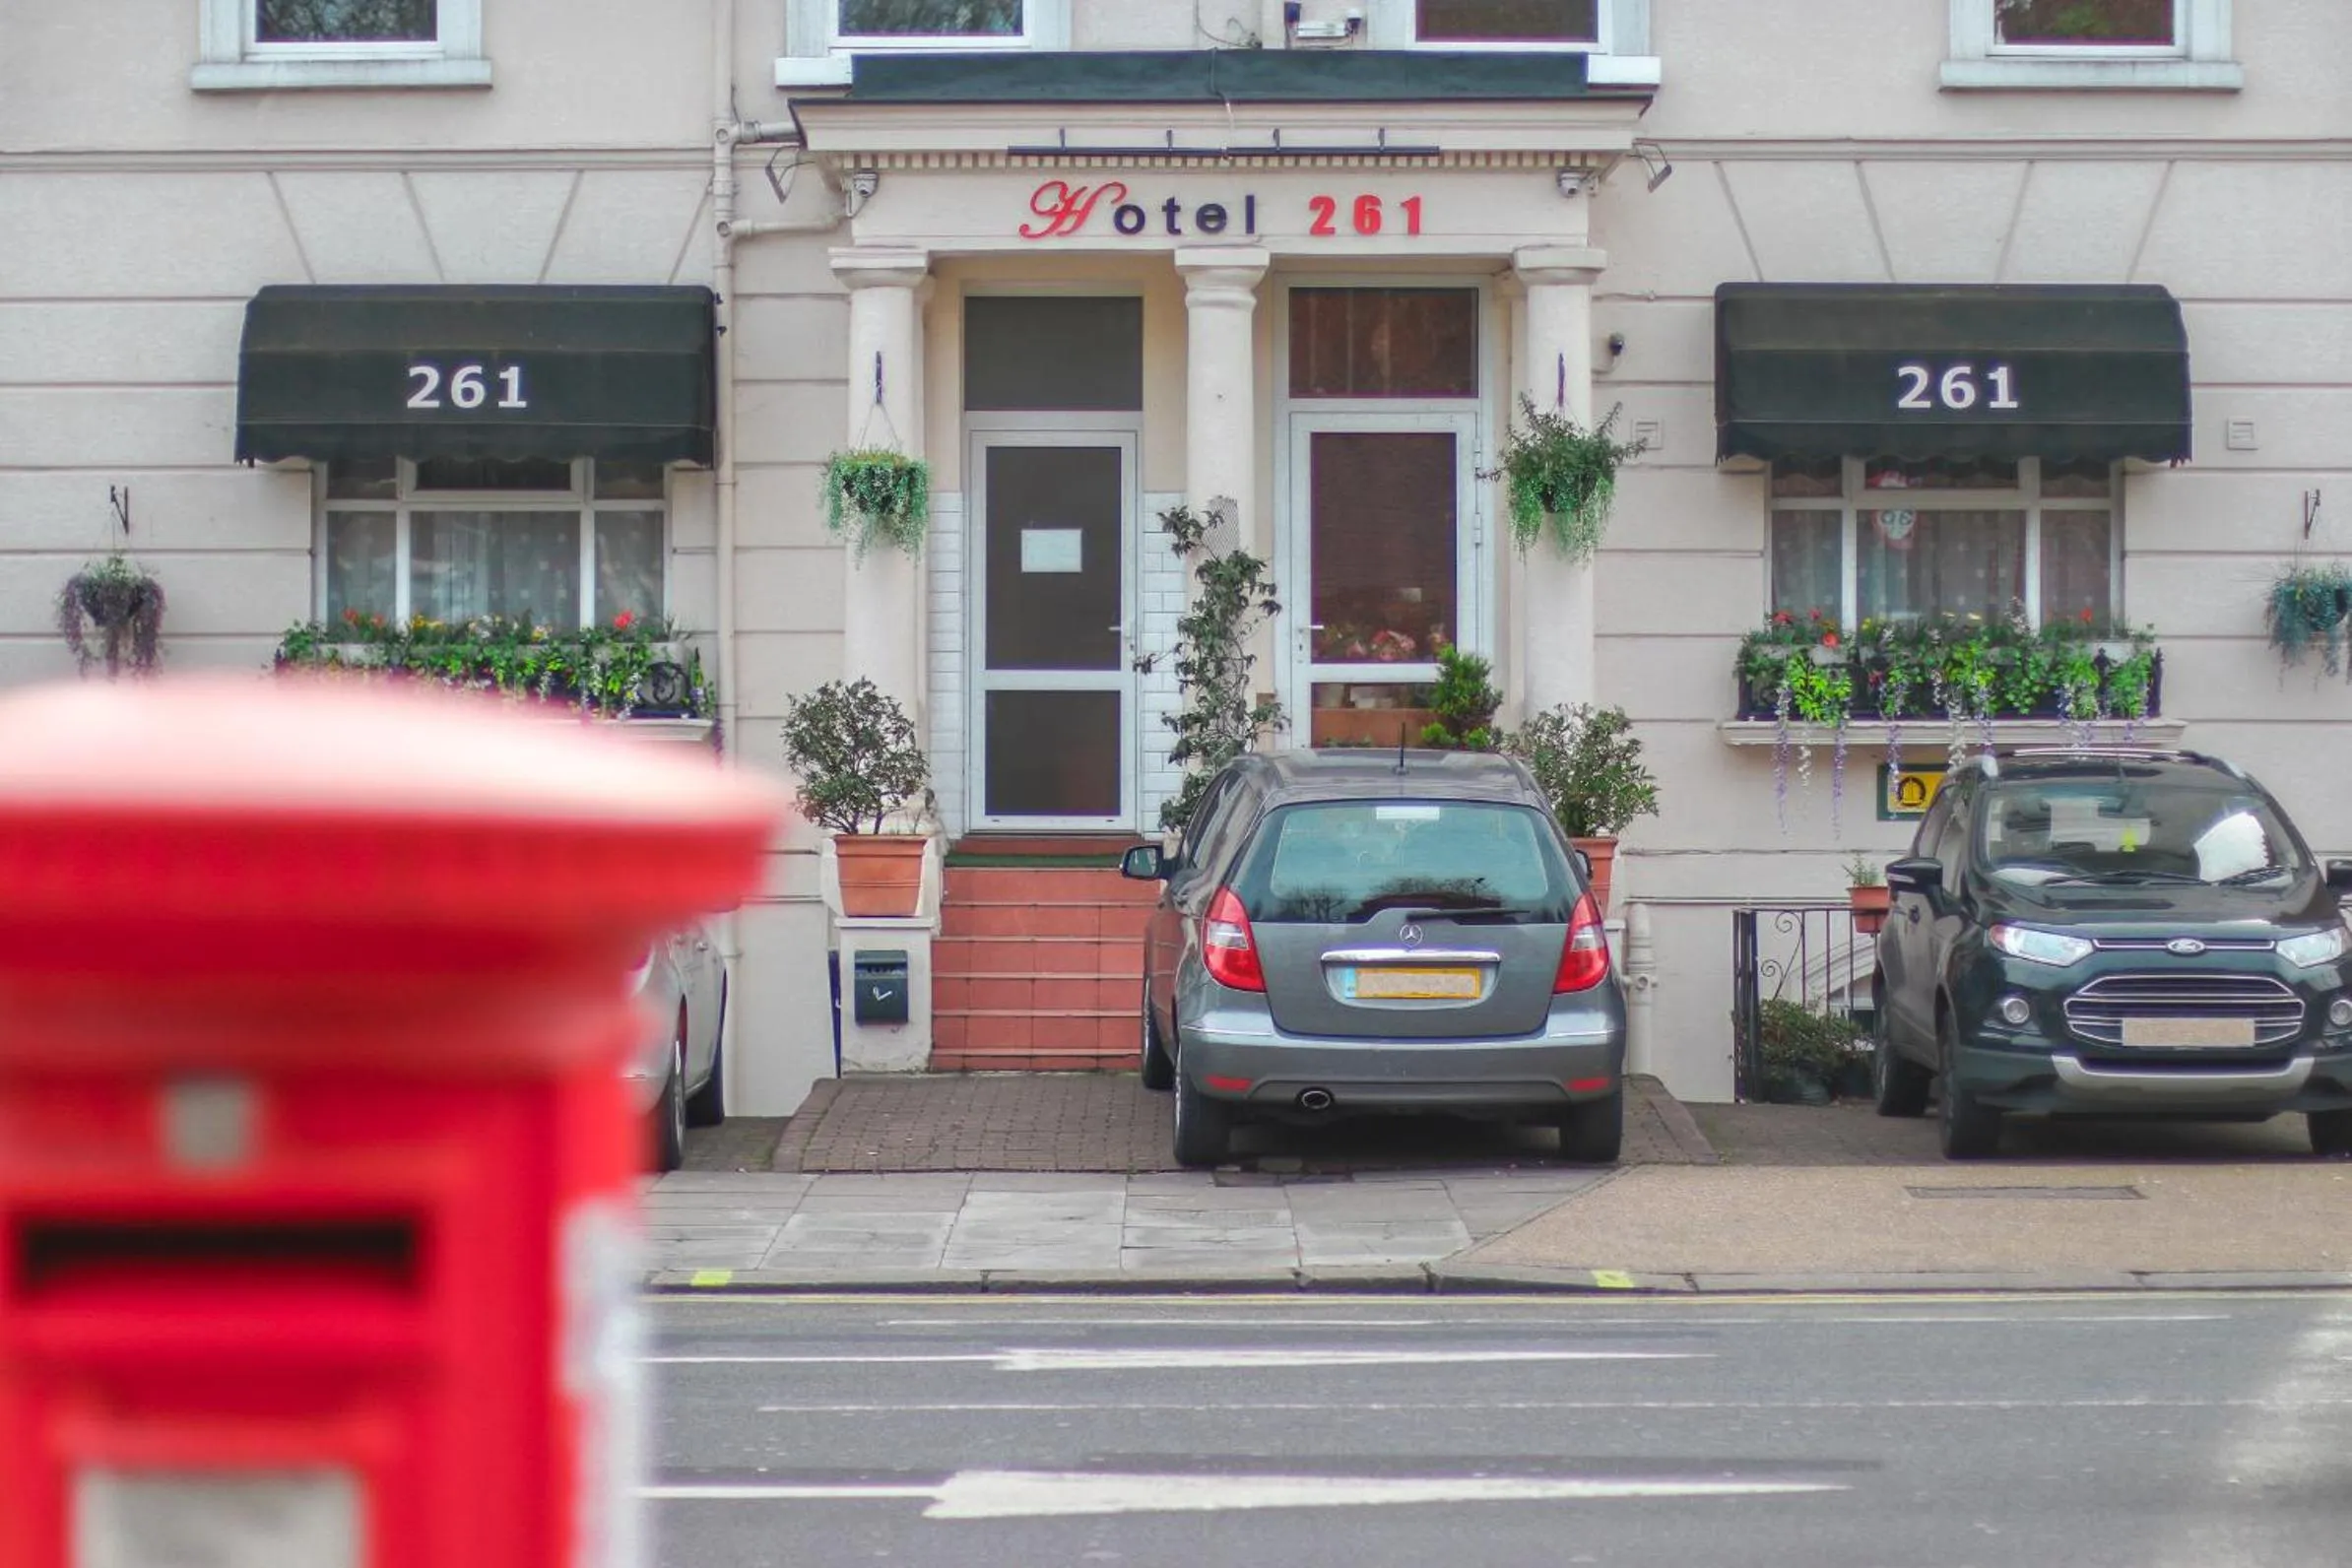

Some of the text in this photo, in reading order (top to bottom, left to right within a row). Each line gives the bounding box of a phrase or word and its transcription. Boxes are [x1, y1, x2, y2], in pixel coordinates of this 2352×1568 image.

[1018, 180, 1422, 239] Hotel 261
[407, 364, 528, 408] 261
[1897, 365, 2018, 409] 261
